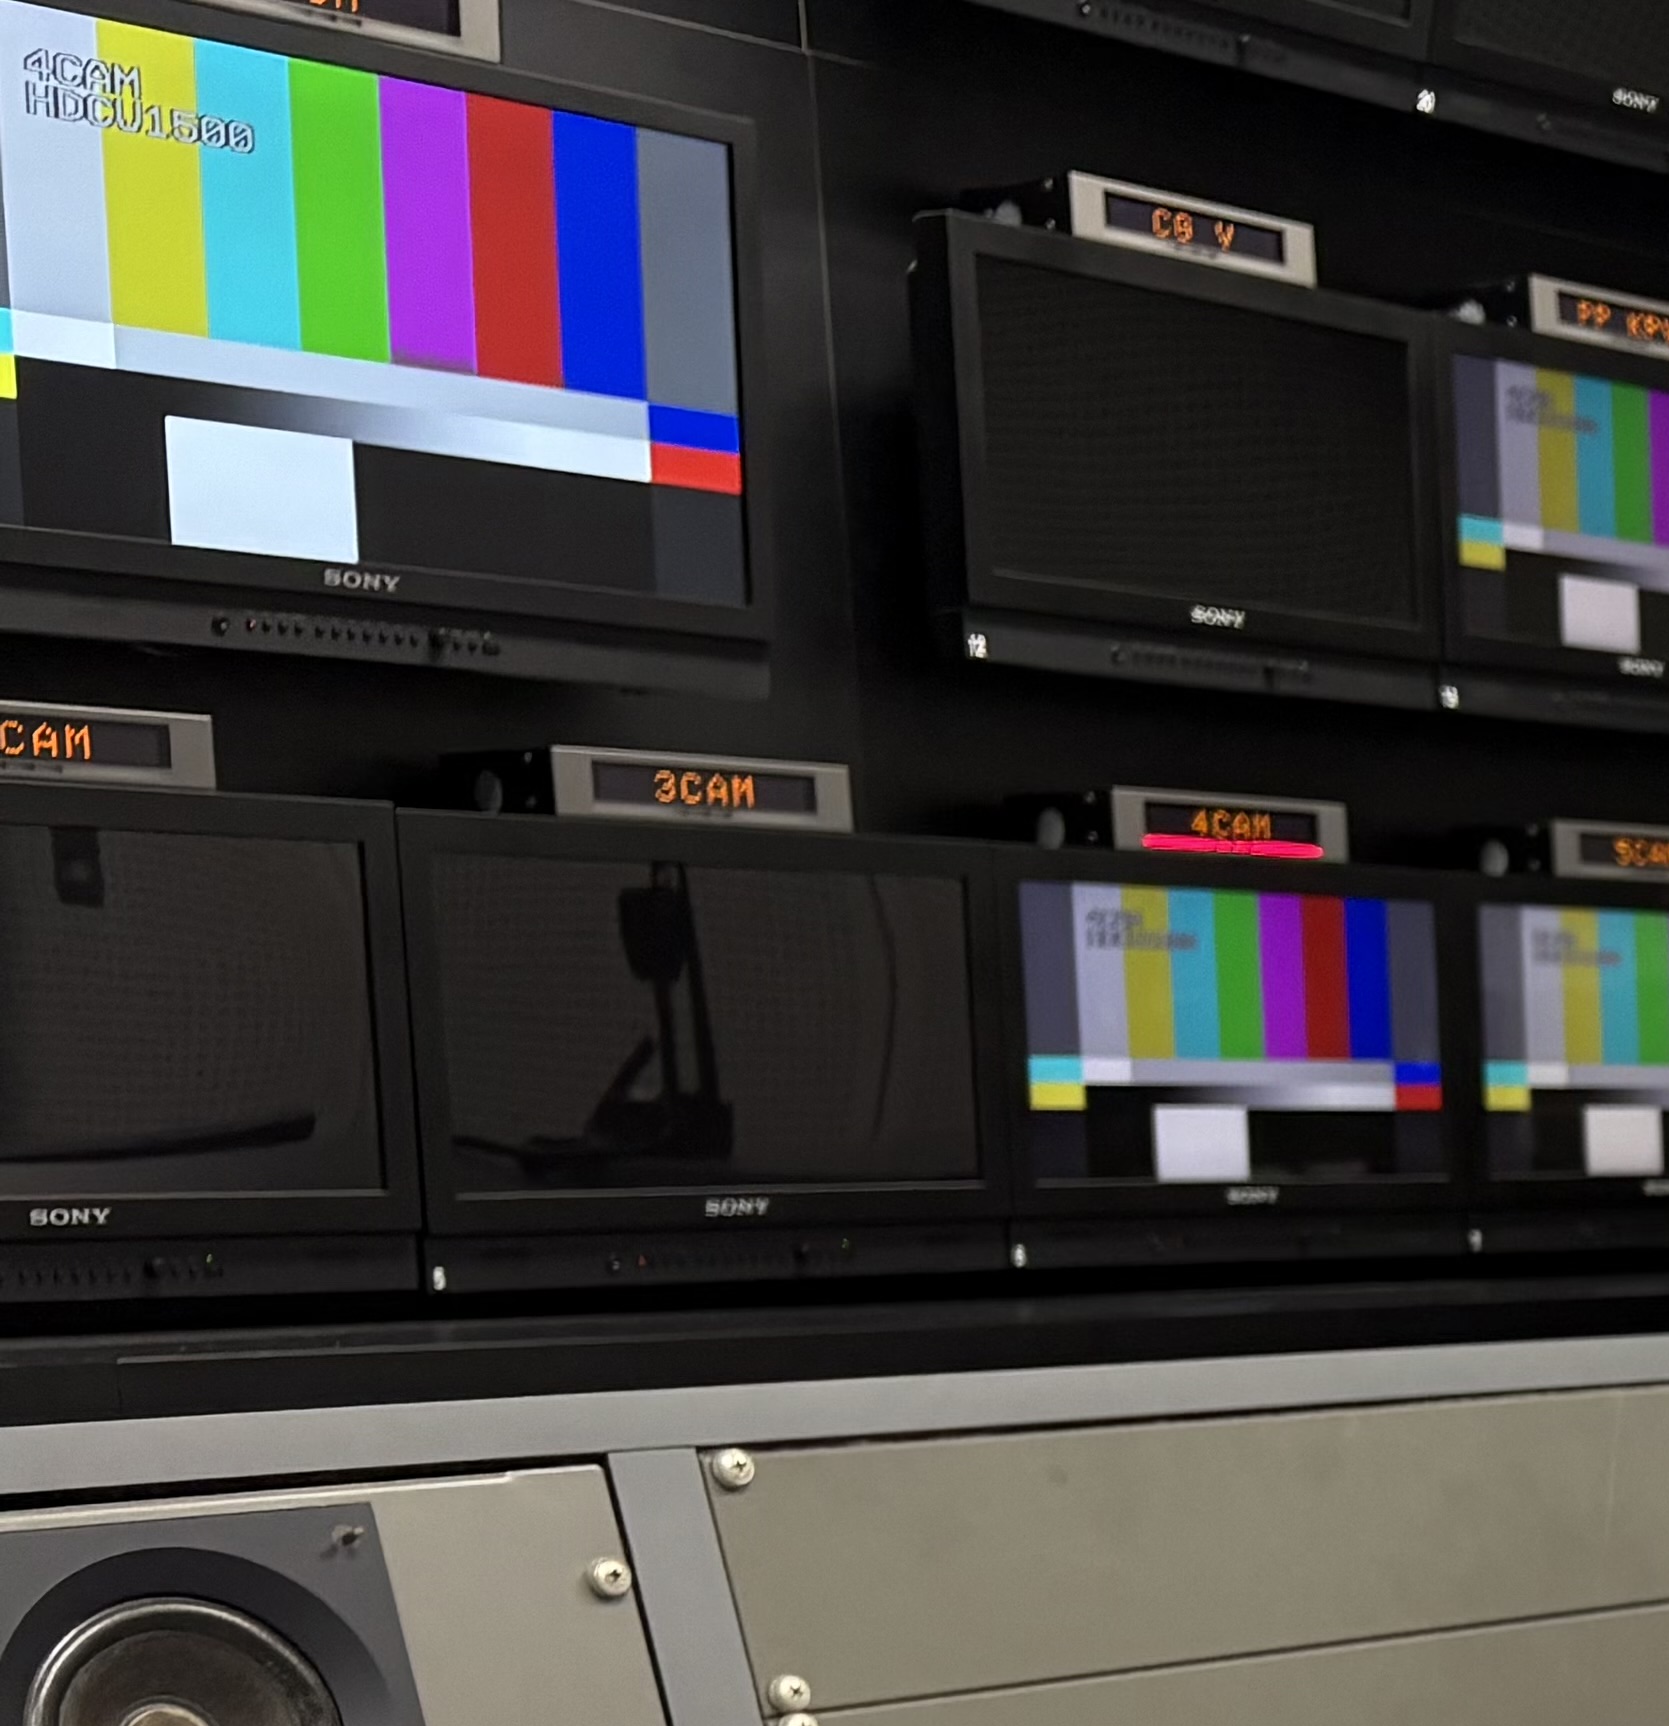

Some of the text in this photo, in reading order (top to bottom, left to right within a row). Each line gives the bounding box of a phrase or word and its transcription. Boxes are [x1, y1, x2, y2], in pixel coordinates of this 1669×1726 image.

[24, 48, 142, 100] 4CAM
[25, 80, 255, 153] HDCU1500
[324, 568, 400, 592] SONY
[1190, 604, 1245, 629] SONY
[0, 720, 91, 760] CAM
[654, 769, 755, 808] 3CAM
[1191, 808, 1272, 840] 4CAM
[29, 1207, 112, 1226] SONY
[705, 1199, 769, 1217] SONY
